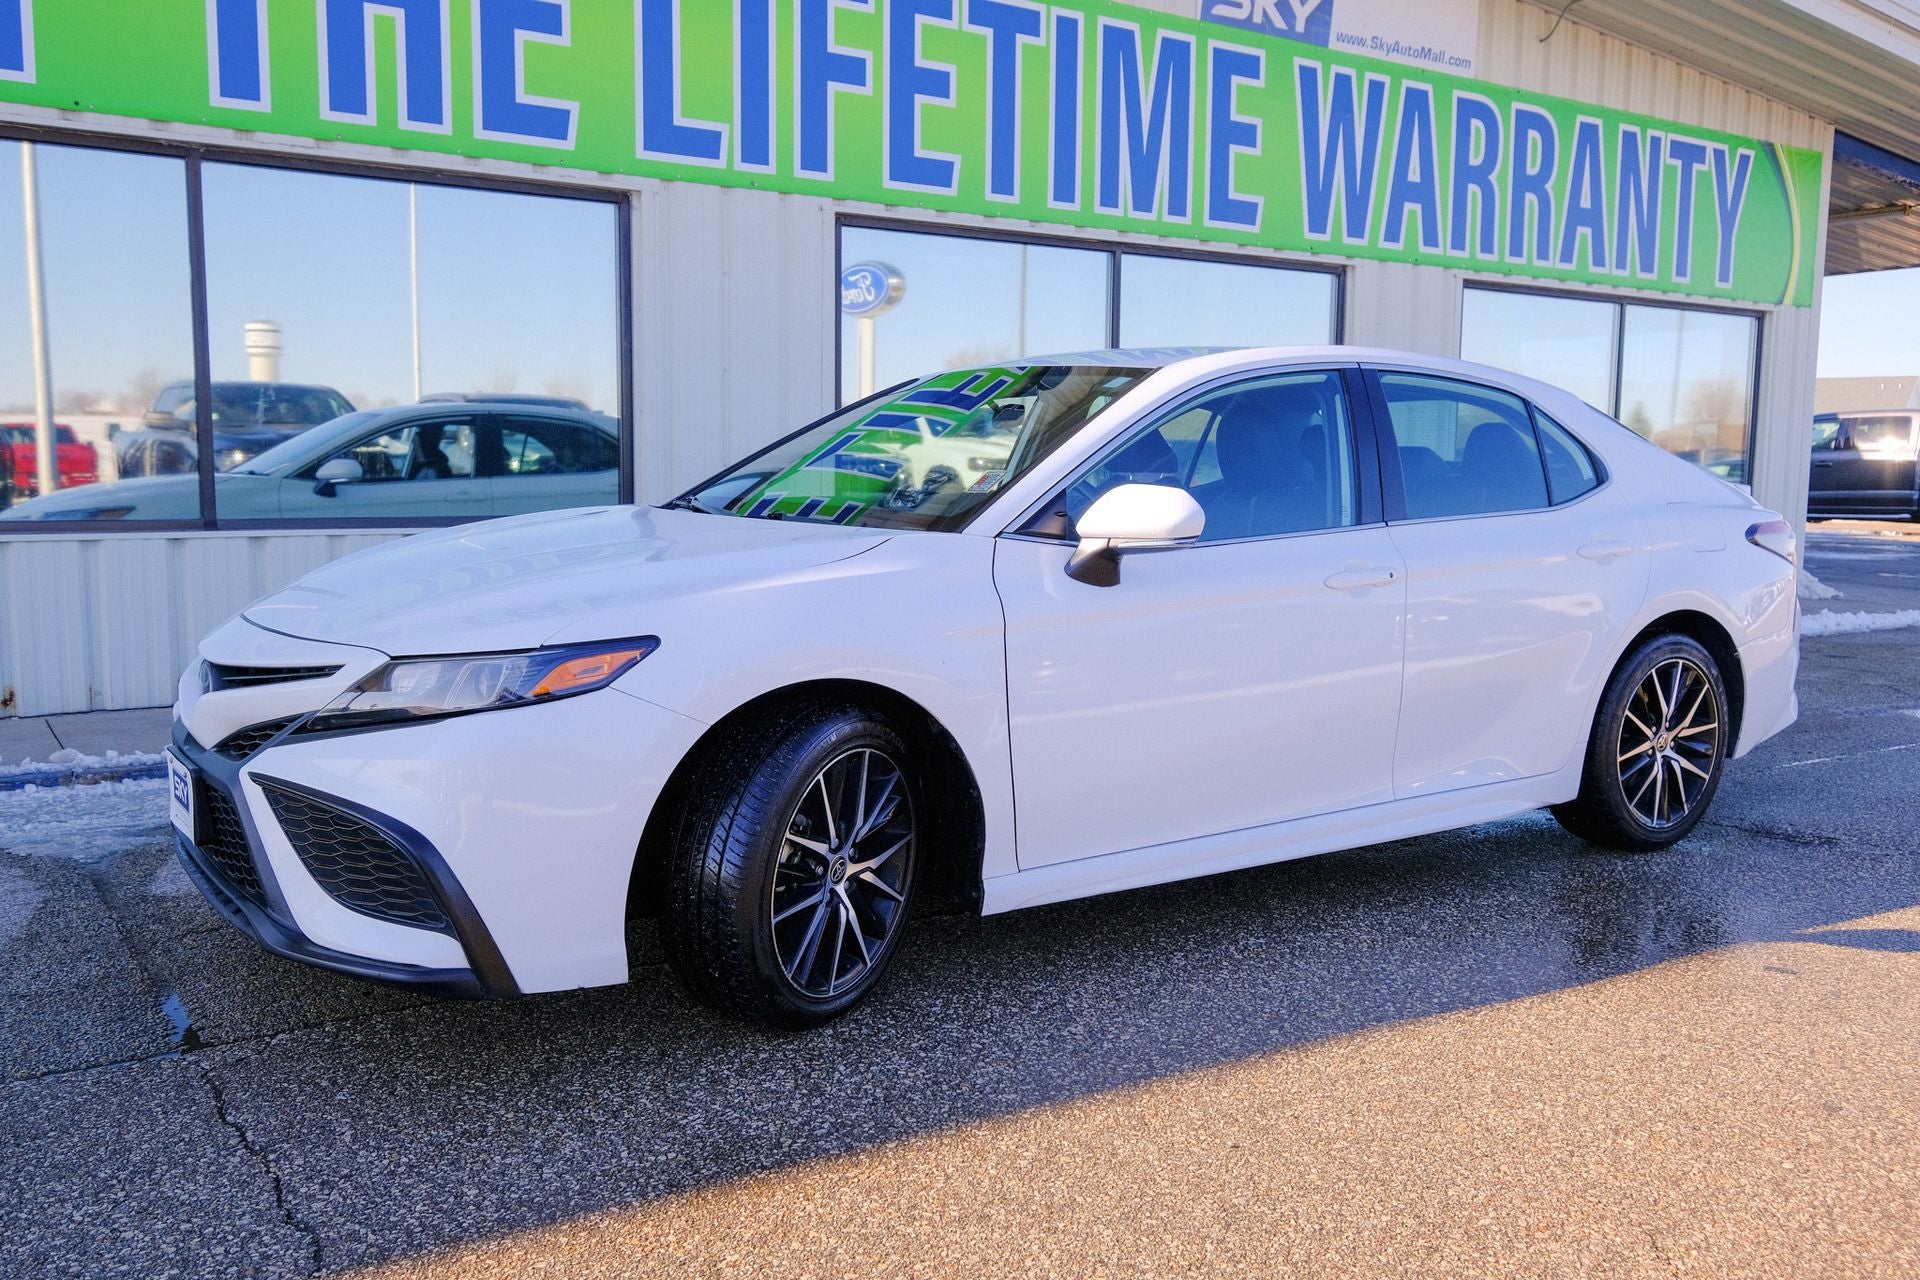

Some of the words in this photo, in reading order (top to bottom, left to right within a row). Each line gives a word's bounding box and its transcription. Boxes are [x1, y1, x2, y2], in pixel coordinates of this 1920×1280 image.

[1210, 0, 1320, 33] SKY
[1336, 31, 1472, 69] www.SkyAutoMall.com
[634, 0, 1266, 233] LIFETIME
[1293, 56, 1755, 289] WARRANTY
